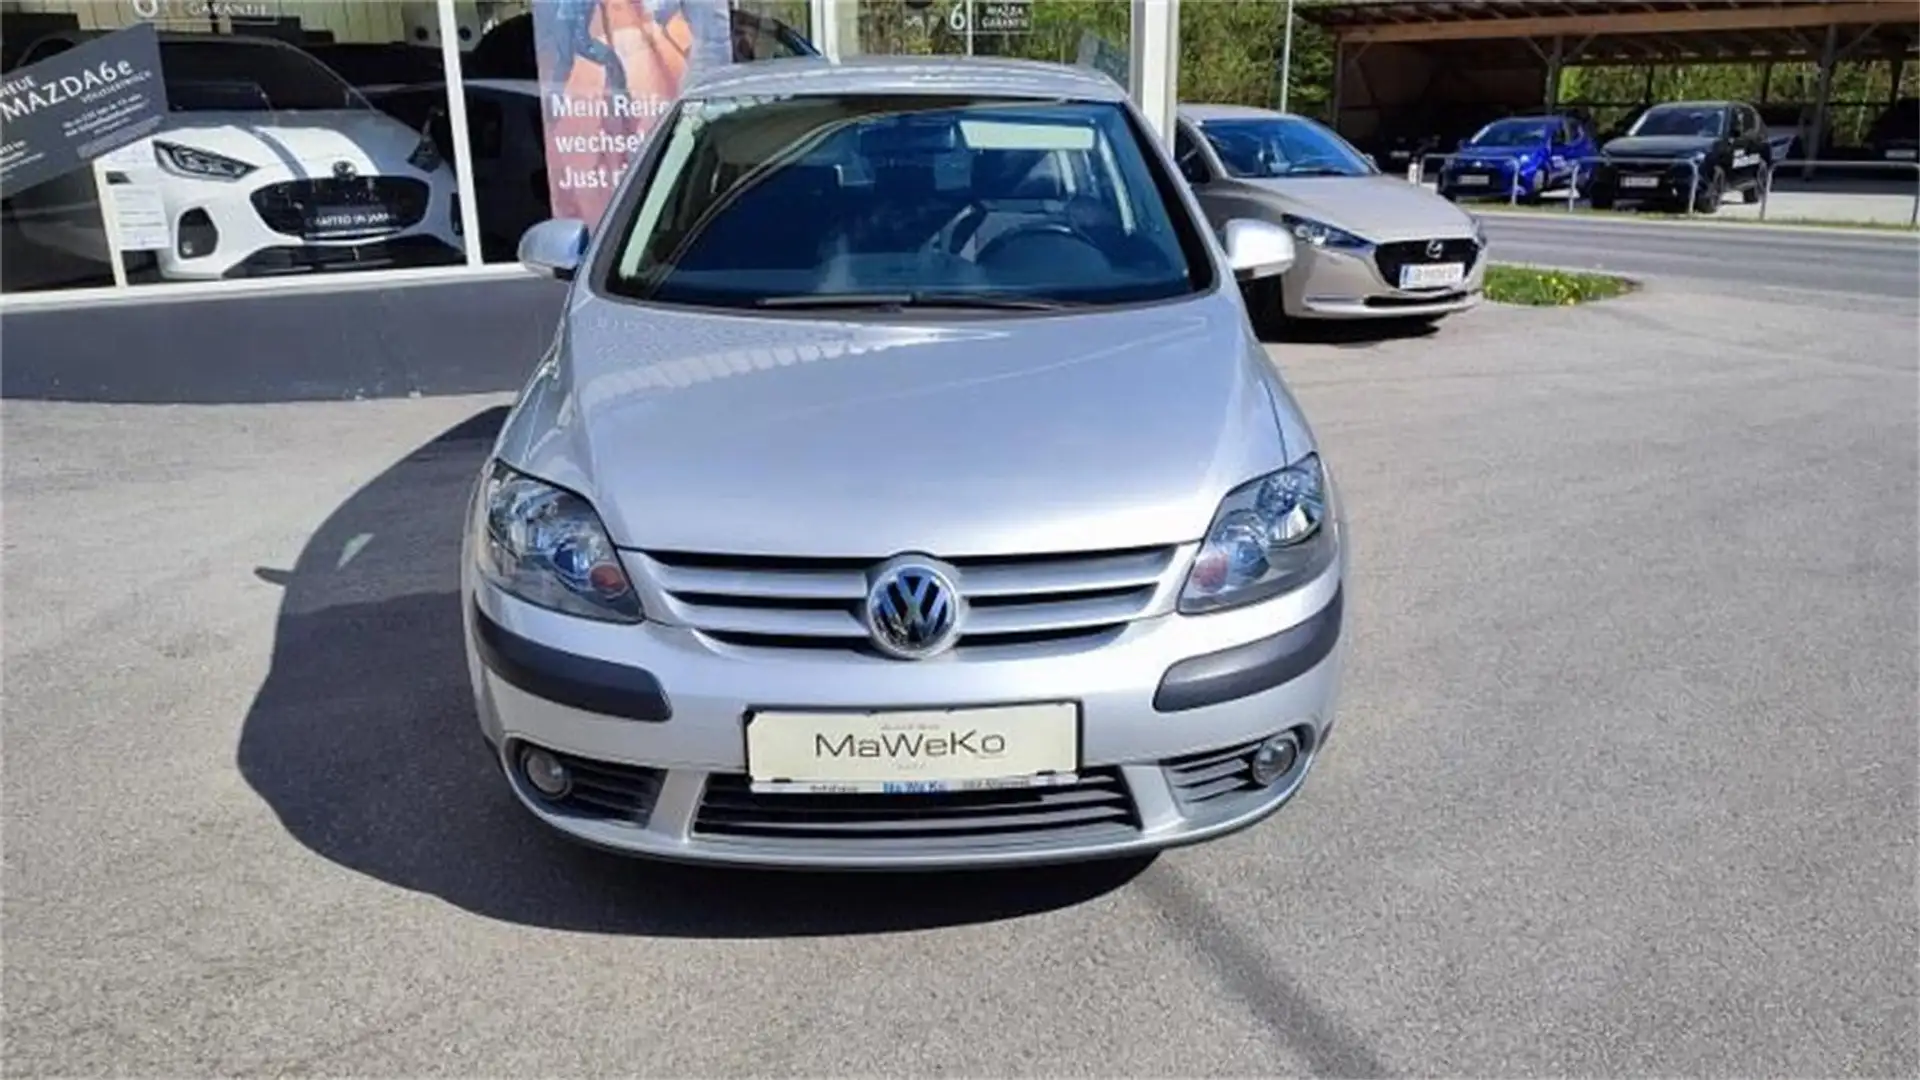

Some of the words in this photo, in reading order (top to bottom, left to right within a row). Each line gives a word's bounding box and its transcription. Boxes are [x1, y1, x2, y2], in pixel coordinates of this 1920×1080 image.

[552, 93, 609, 117] Mein
[559, 165, 608, 189] Just
[815, 730, 1006, 758] MaWeKo
